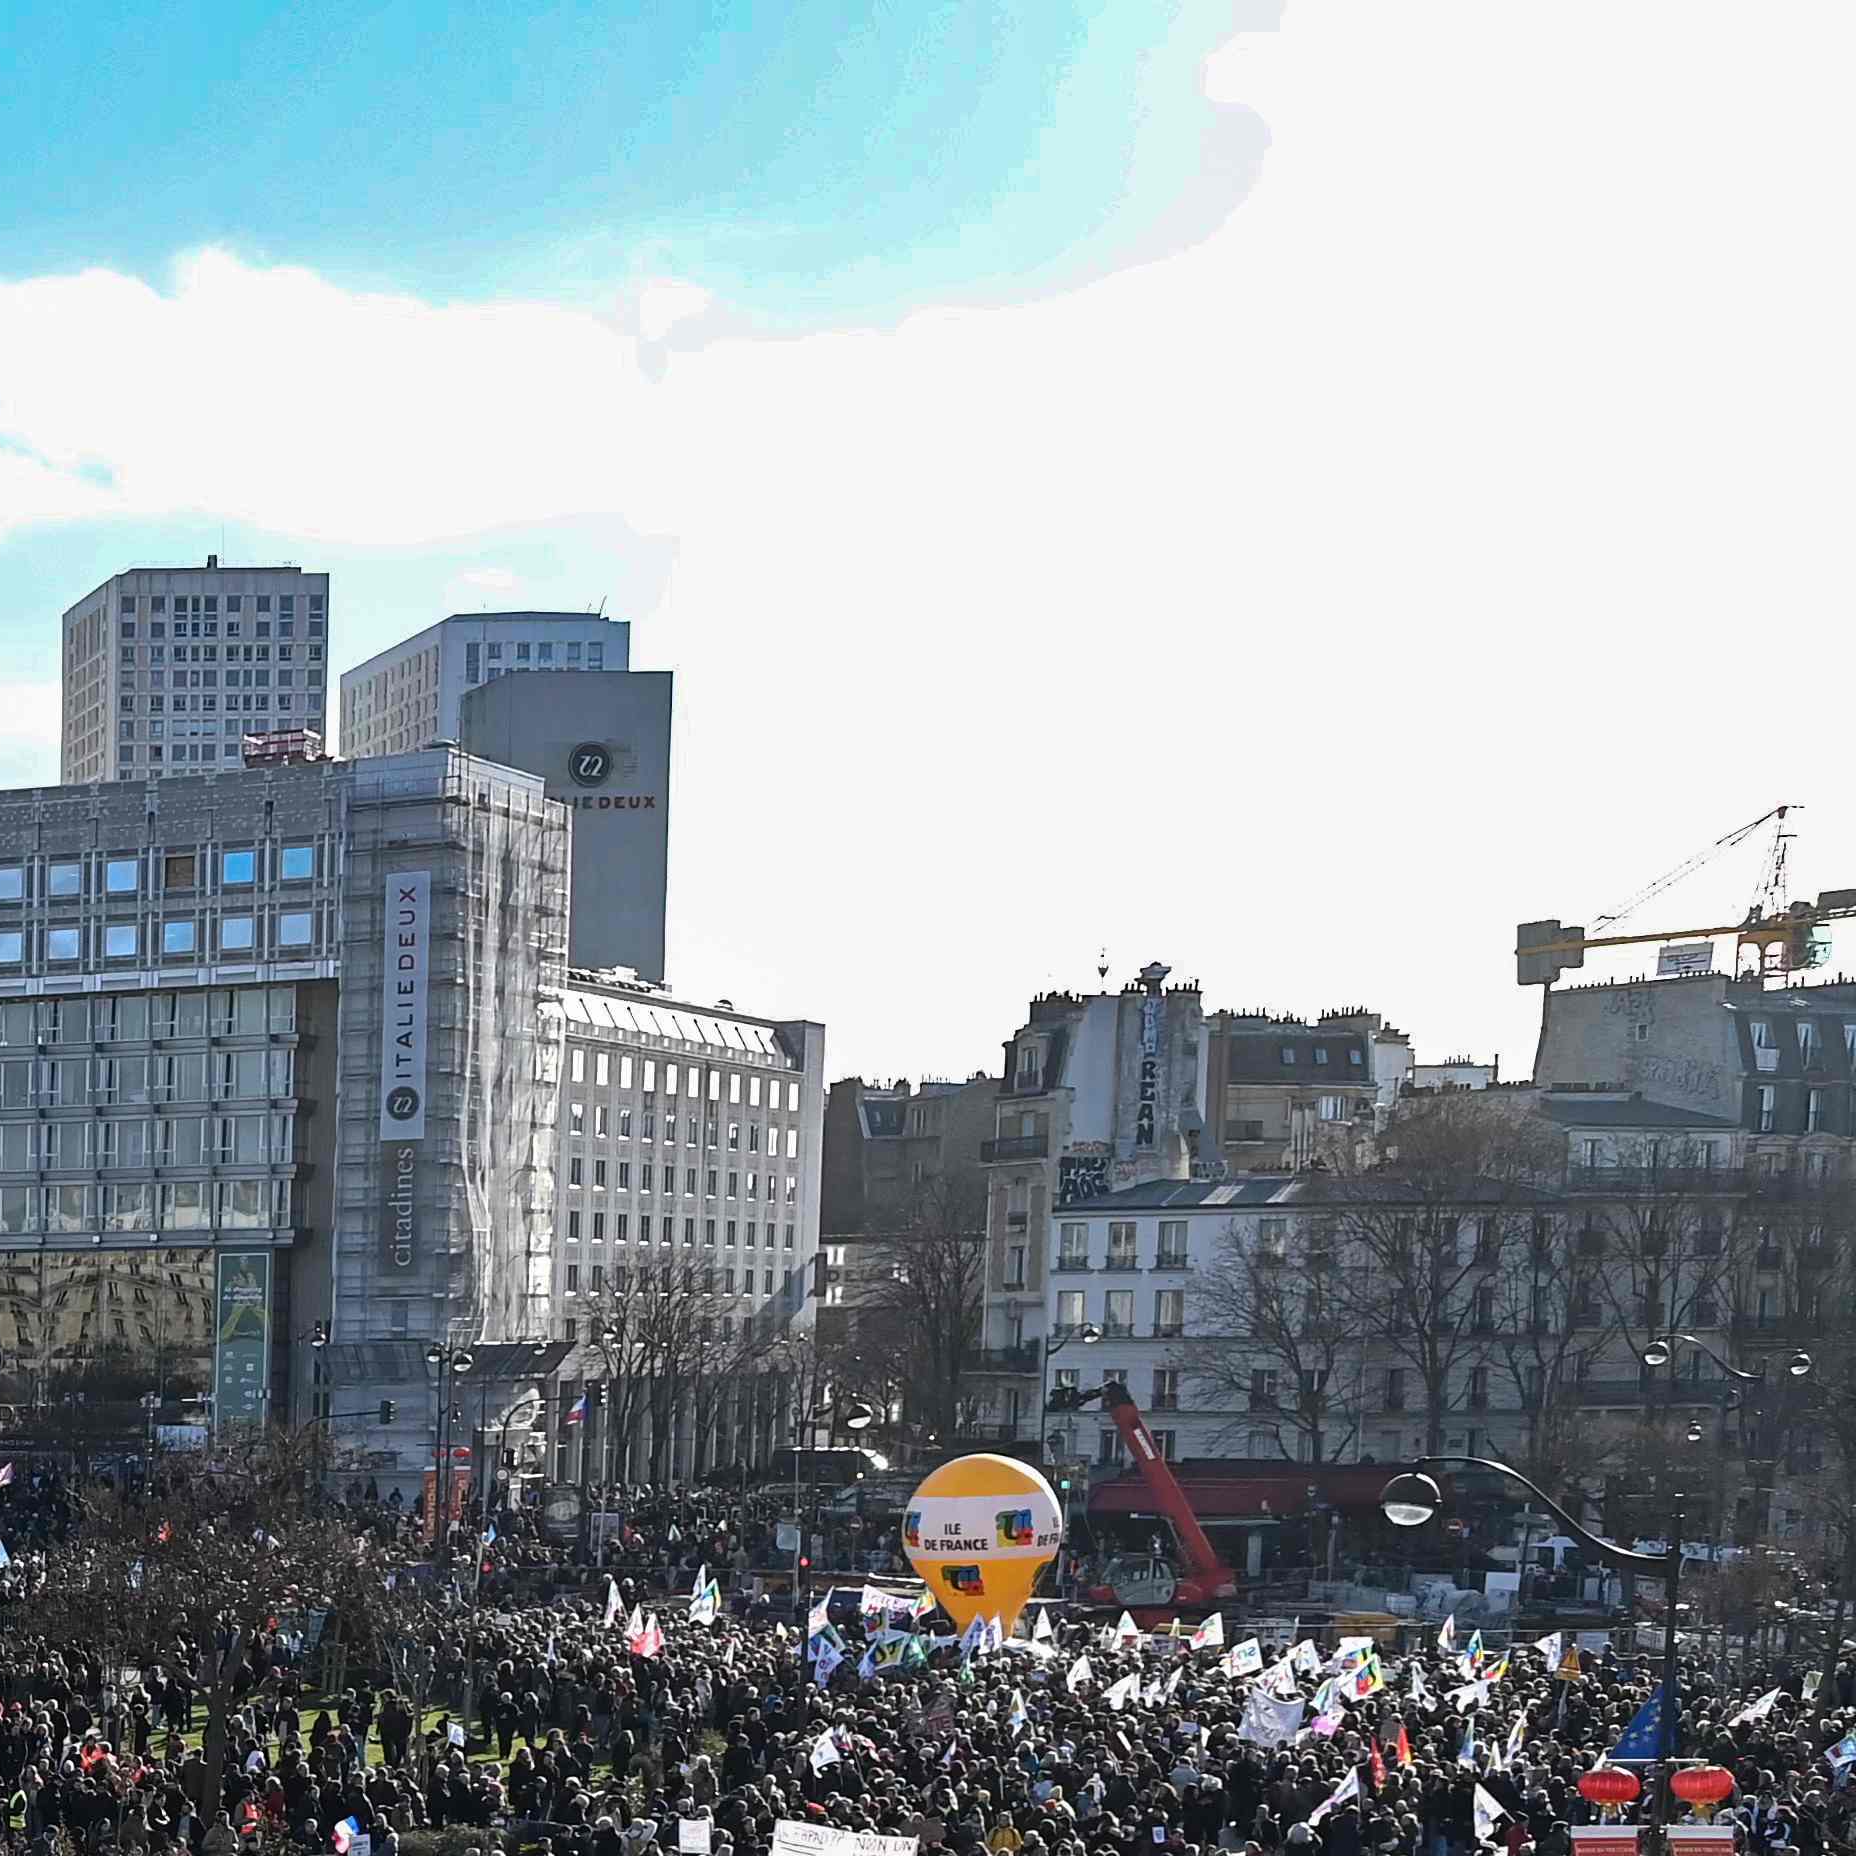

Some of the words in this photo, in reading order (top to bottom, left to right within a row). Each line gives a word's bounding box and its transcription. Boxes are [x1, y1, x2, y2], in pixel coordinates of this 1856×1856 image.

[388, 1146, 413, 1267] citadines
[944, 1523, 961, 1535] ILE
[924, 1539, 937, 1550] DE
[939, 1538, 988, 1551] FRANCE
